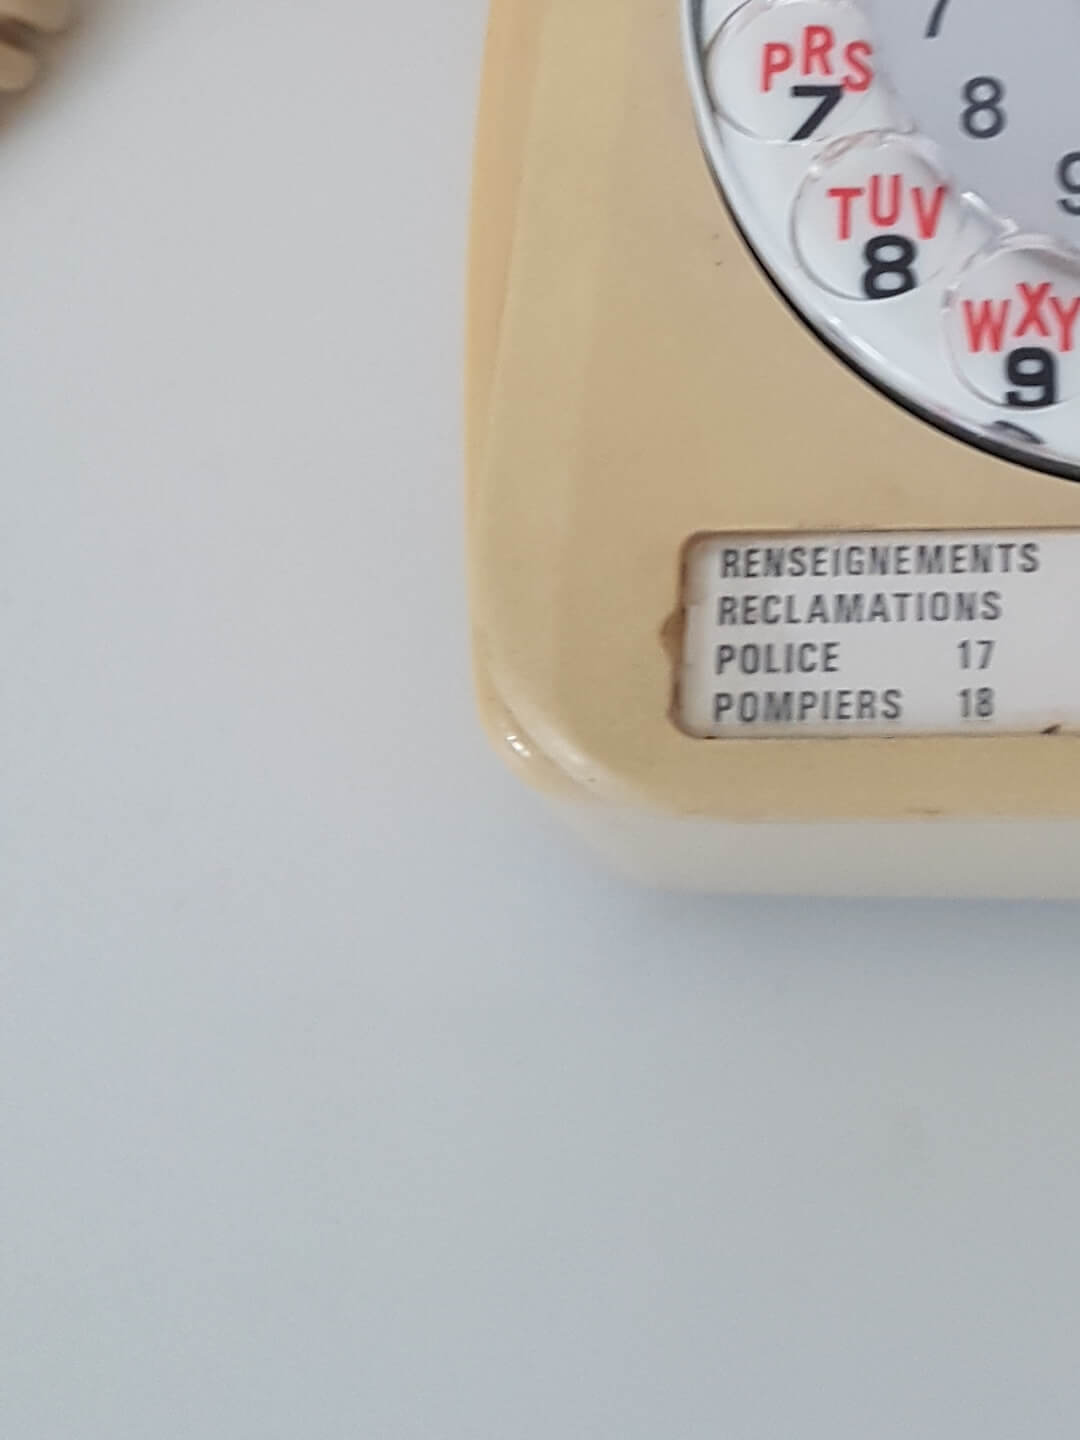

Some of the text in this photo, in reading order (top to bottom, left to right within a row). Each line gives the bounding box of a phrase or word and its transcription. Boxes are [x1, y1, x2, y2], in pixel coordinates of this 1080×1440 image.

[761, 25, 873, 92] PRS
[790, 84, 843, 141] 7
[960, 76, 1006, 139] 8
[827, 173, 950, 240] TUV
[862, 234, 918, 300] 8
[1005, 346, 1056, 408] 9
[720, 542, 1041, 579] RENSEIGNEMENTS
[717, 591, 1001, 626] RECLAMATIONS
[715, 639, 996, 676] POLICE 17
[714, 687, 996, 724] POMPIERS 18
